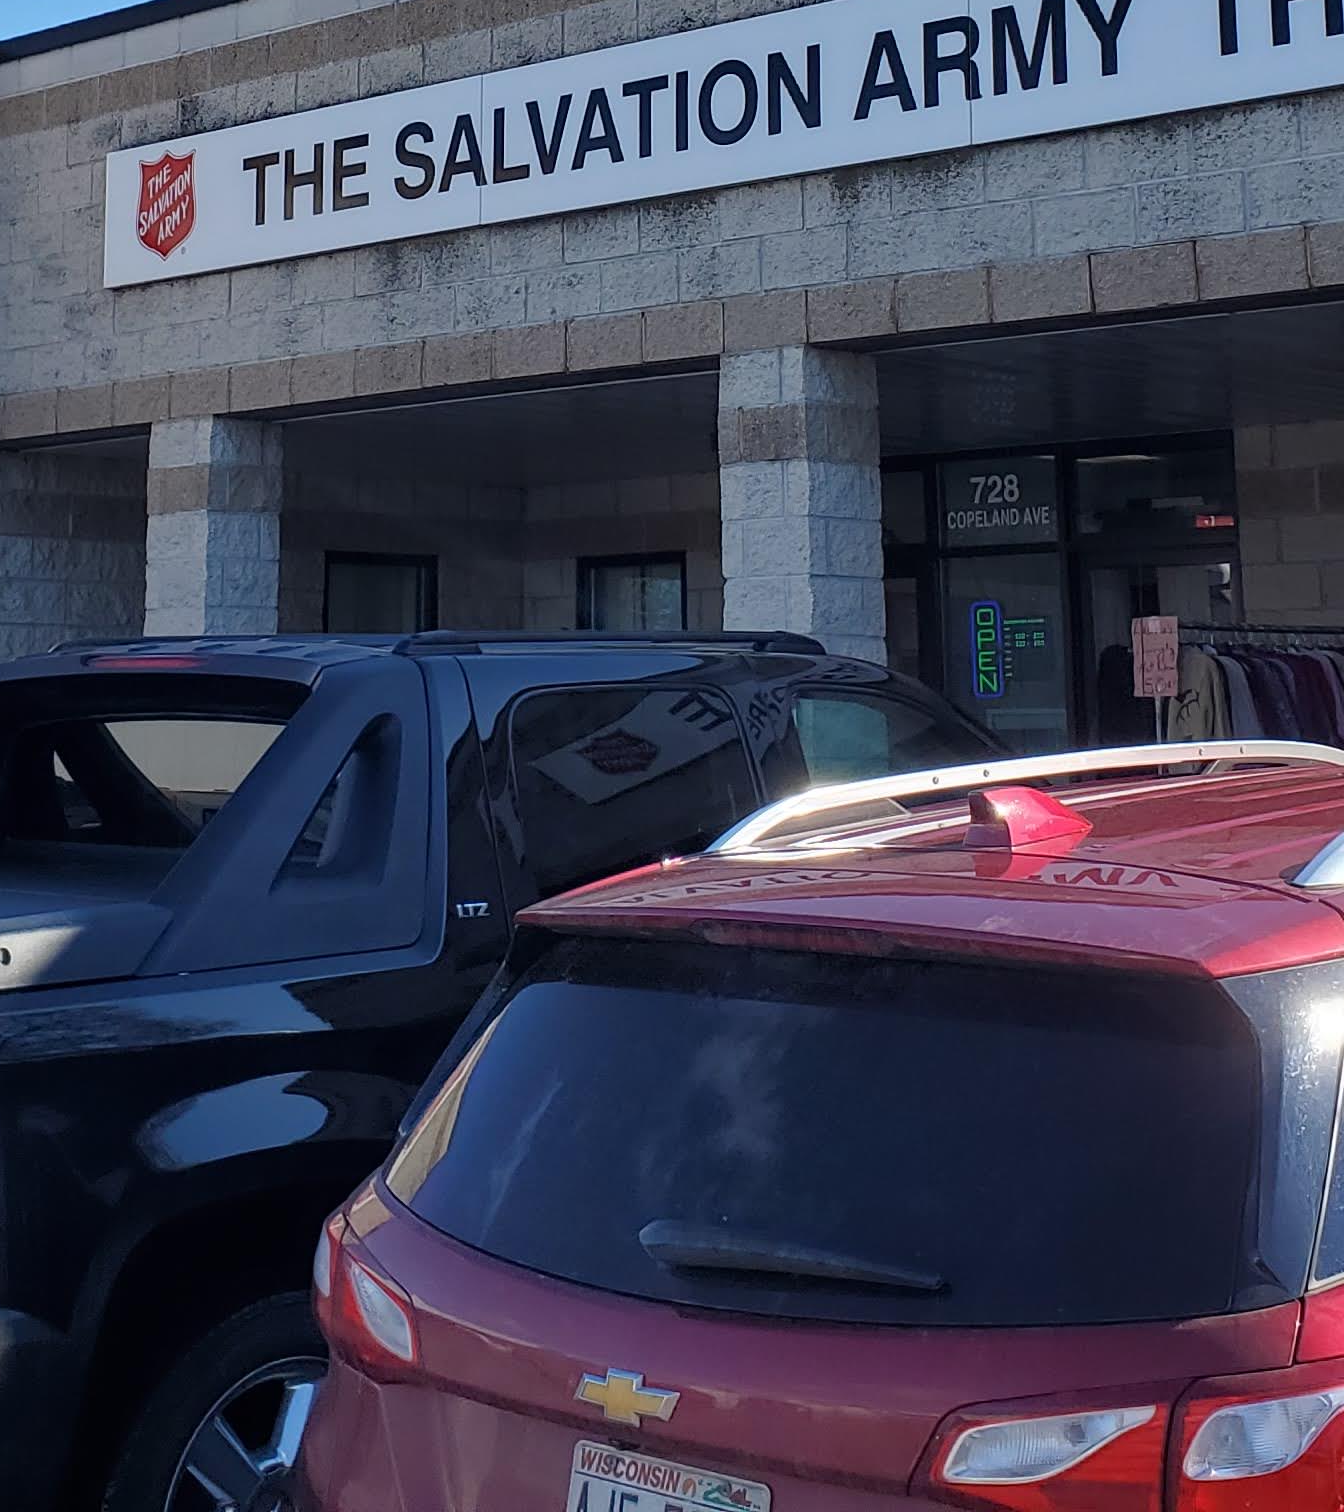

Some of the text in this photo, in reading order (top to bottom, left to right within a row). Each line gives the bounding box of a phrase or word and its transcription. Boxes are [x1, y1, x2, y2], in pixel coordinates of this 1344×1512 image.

[242, 133, 370, 226] THE
[393, 43, 822, 200] SALVATION
[140, 164, 191, 236] SALVATION
[147, 163, 172, 199] THE
[157, 194, 189, 245] ARMY
[969, 473, 1020, 504] 728
[947, 506, 1051, 529] COPELAND AVE
[976, 608, 998, 694] OPEN
[456, 902, 492, 919] LTZ
[580, 1446, 682, 1495] WISCONSIN
